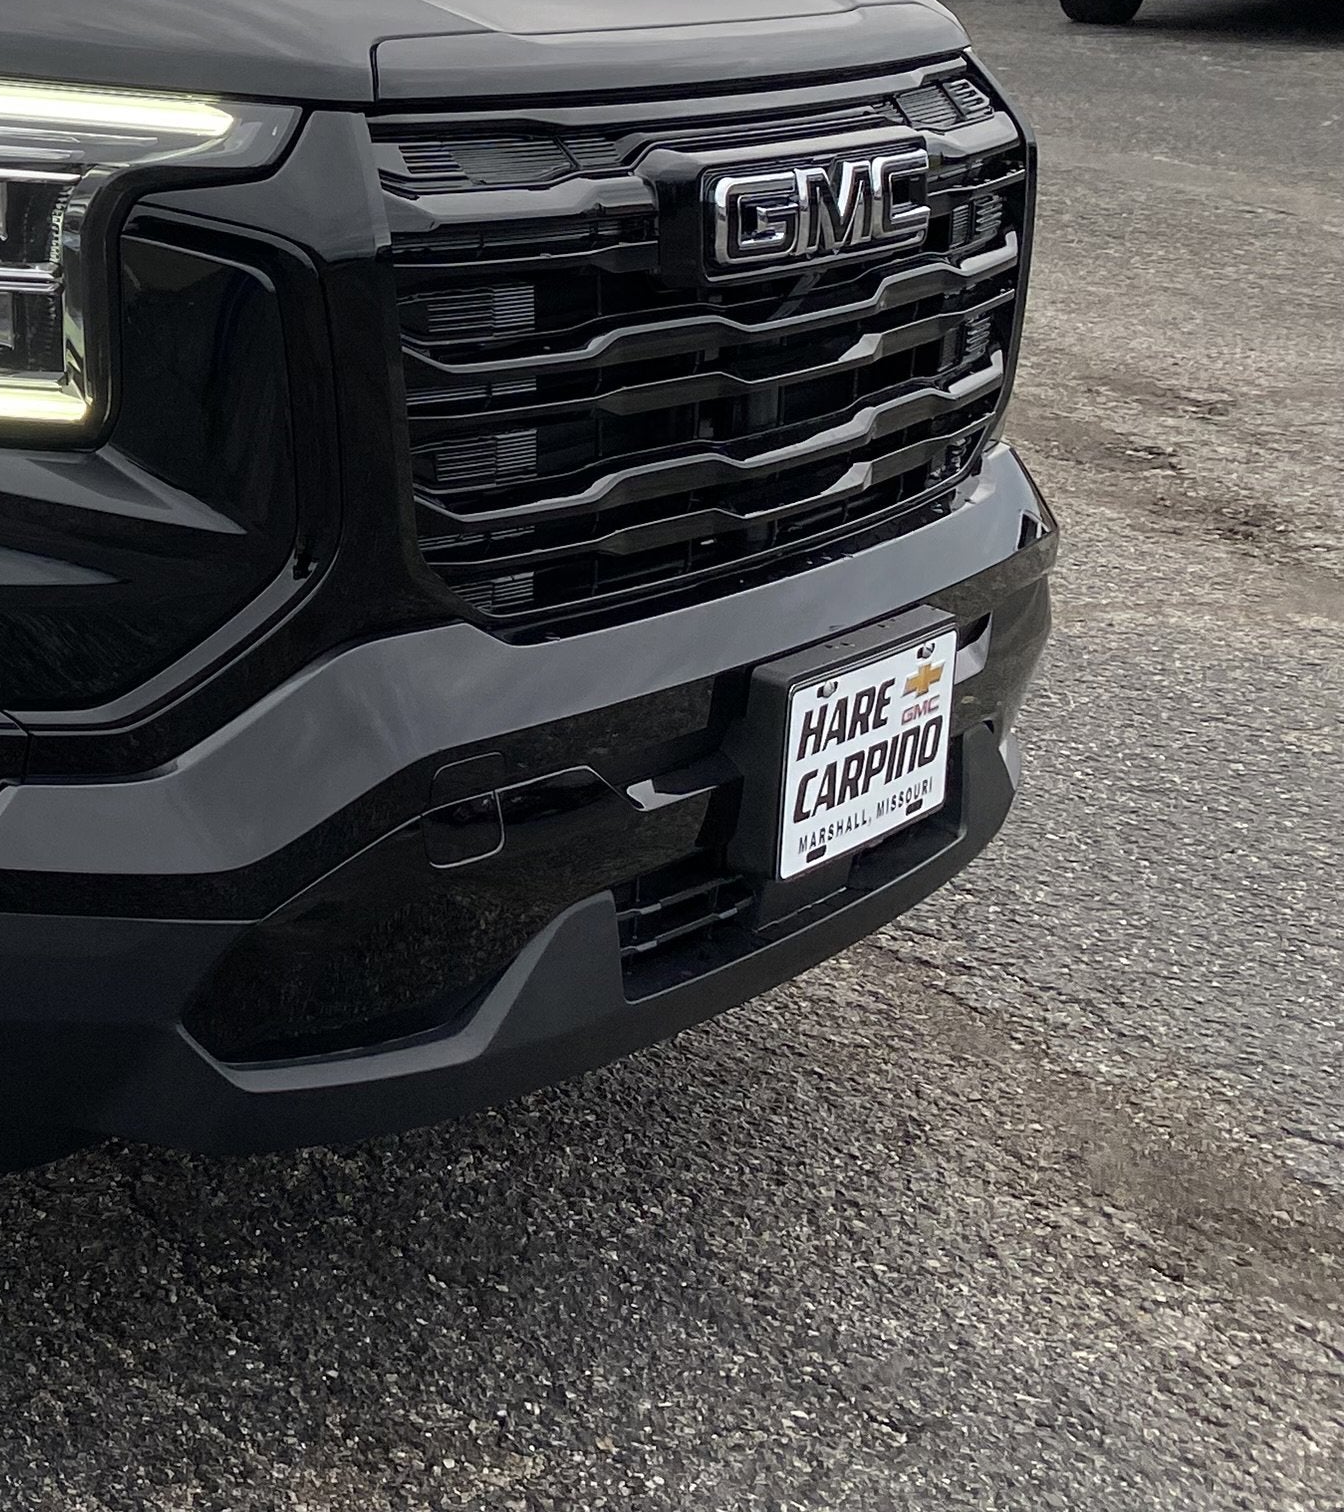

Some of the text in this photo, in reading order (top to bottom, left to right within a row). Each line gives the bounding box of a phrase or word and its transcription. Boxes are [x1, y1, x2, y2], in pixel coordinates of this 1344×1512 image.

[714, 148, 932, 265] GMC
[795, 677, 896, 762] HARE
[901, 694, 940, 726] GMC
[793, 715, 944, 824] CARPINO
[876, 776, 933, 818] MISSOURI
